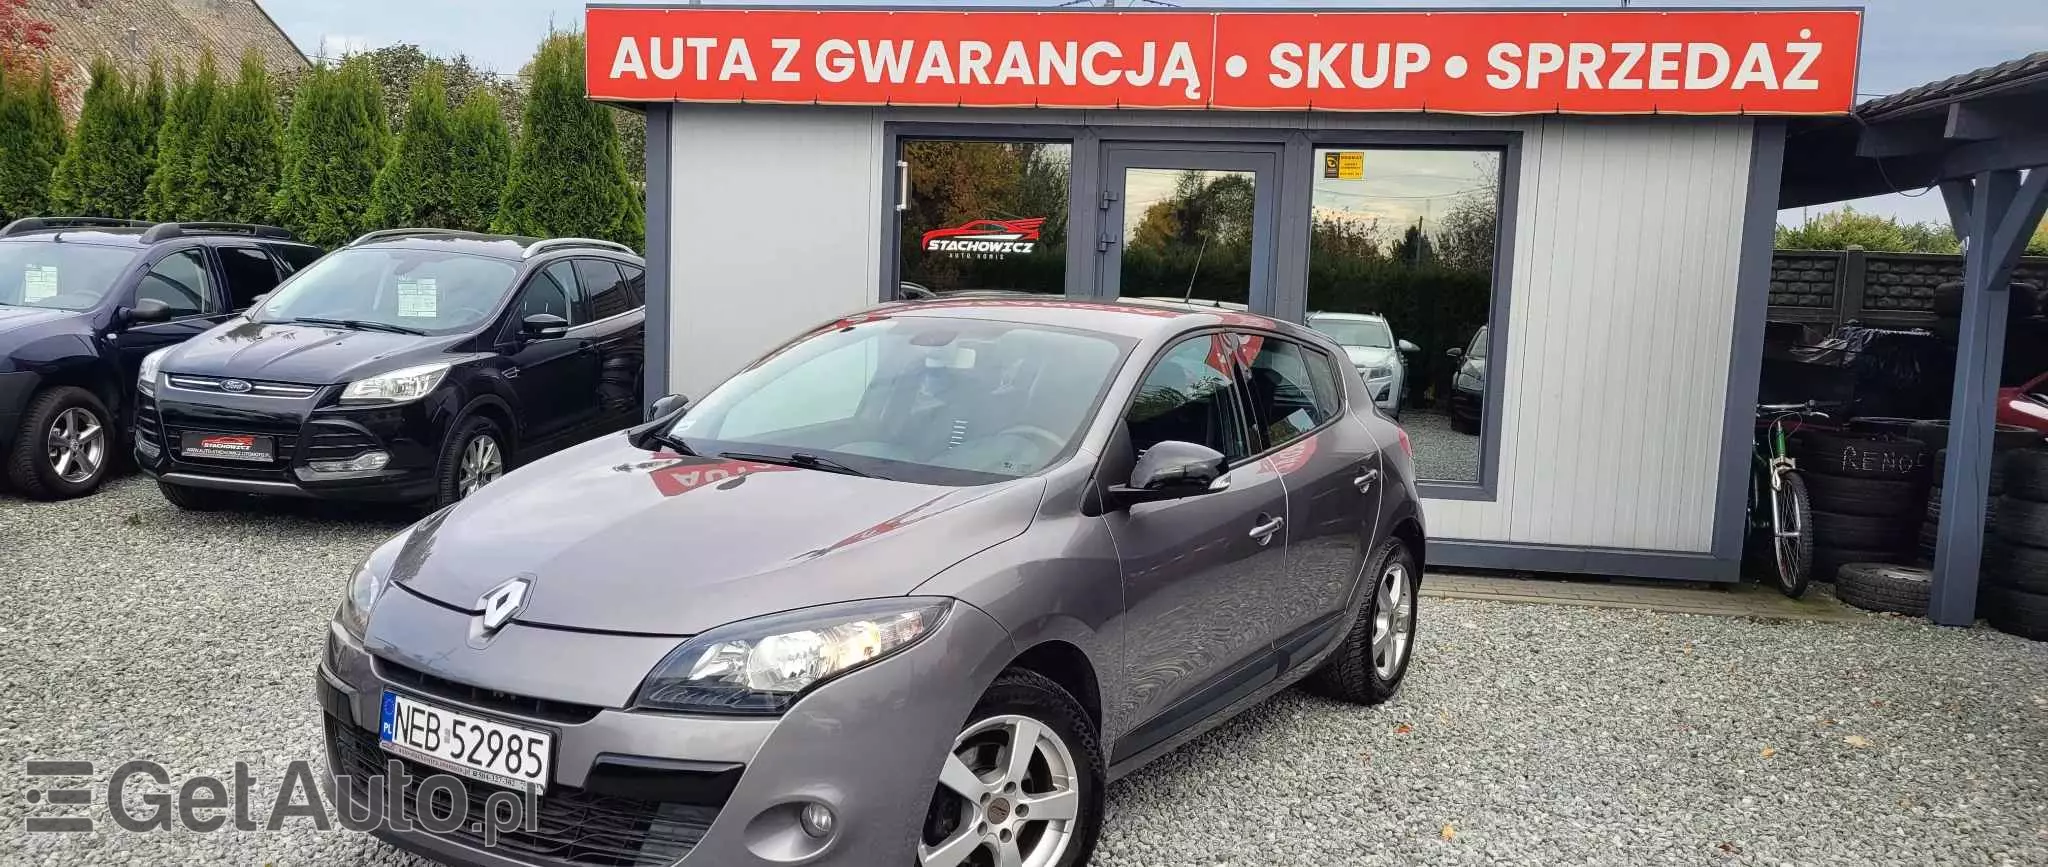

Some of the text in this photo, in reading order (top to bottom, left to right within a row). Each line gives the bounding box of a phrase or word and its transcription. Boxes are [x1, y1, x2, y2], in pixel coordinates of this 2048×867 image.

[609, 36, 1202, 99] AUTA Z GWARANCJĄ
[1269, 28, 1824, 91] SKUP SPRZEDAŻ
[927, 240, 1035, 253] STACHOWICZ
[383, 722, 393, 734] PL
[394, 702, 544, 779] NEB 52985
